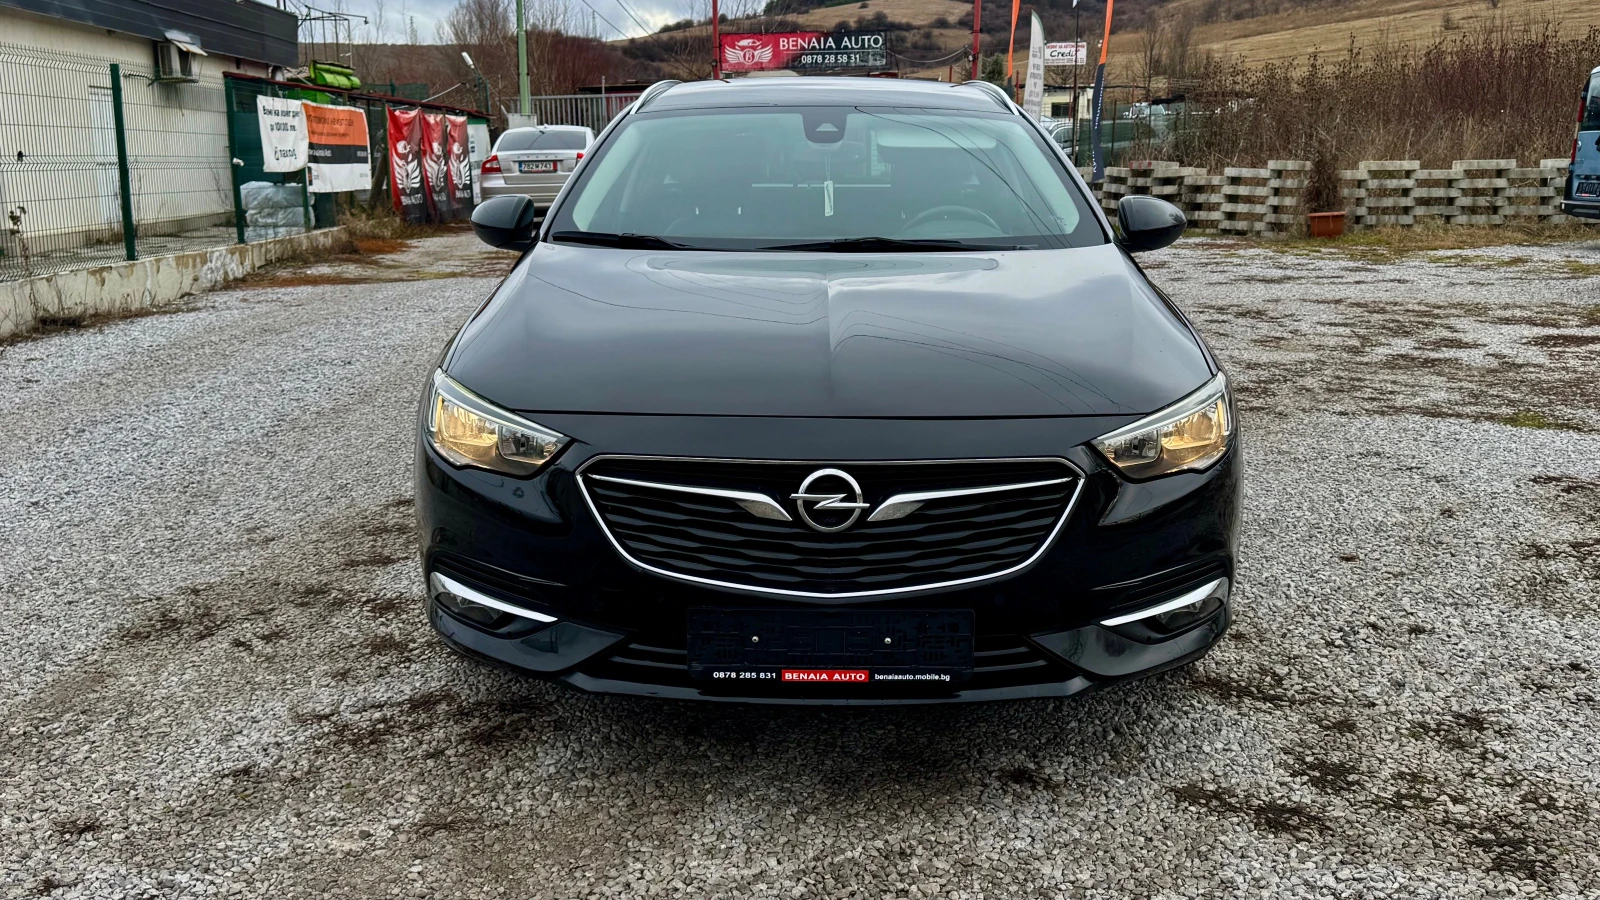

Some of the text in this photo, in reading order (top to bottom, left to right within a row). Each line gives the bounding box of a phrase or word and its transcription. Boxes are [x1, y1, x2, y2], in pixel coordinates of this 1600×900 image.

[779, 35, 883, 50] BENAIA AUTO
[801, 54, 860, 63] 0878 28 58 31
[713, 671, 737, 679] 0878
[739, 671, 757, 679] 285
[784, 672, 829, 680] BENAIA
[832, 673, 866, 681] AUTO
[874, 673, 951, 682] benaiaauto.mobile.bg
